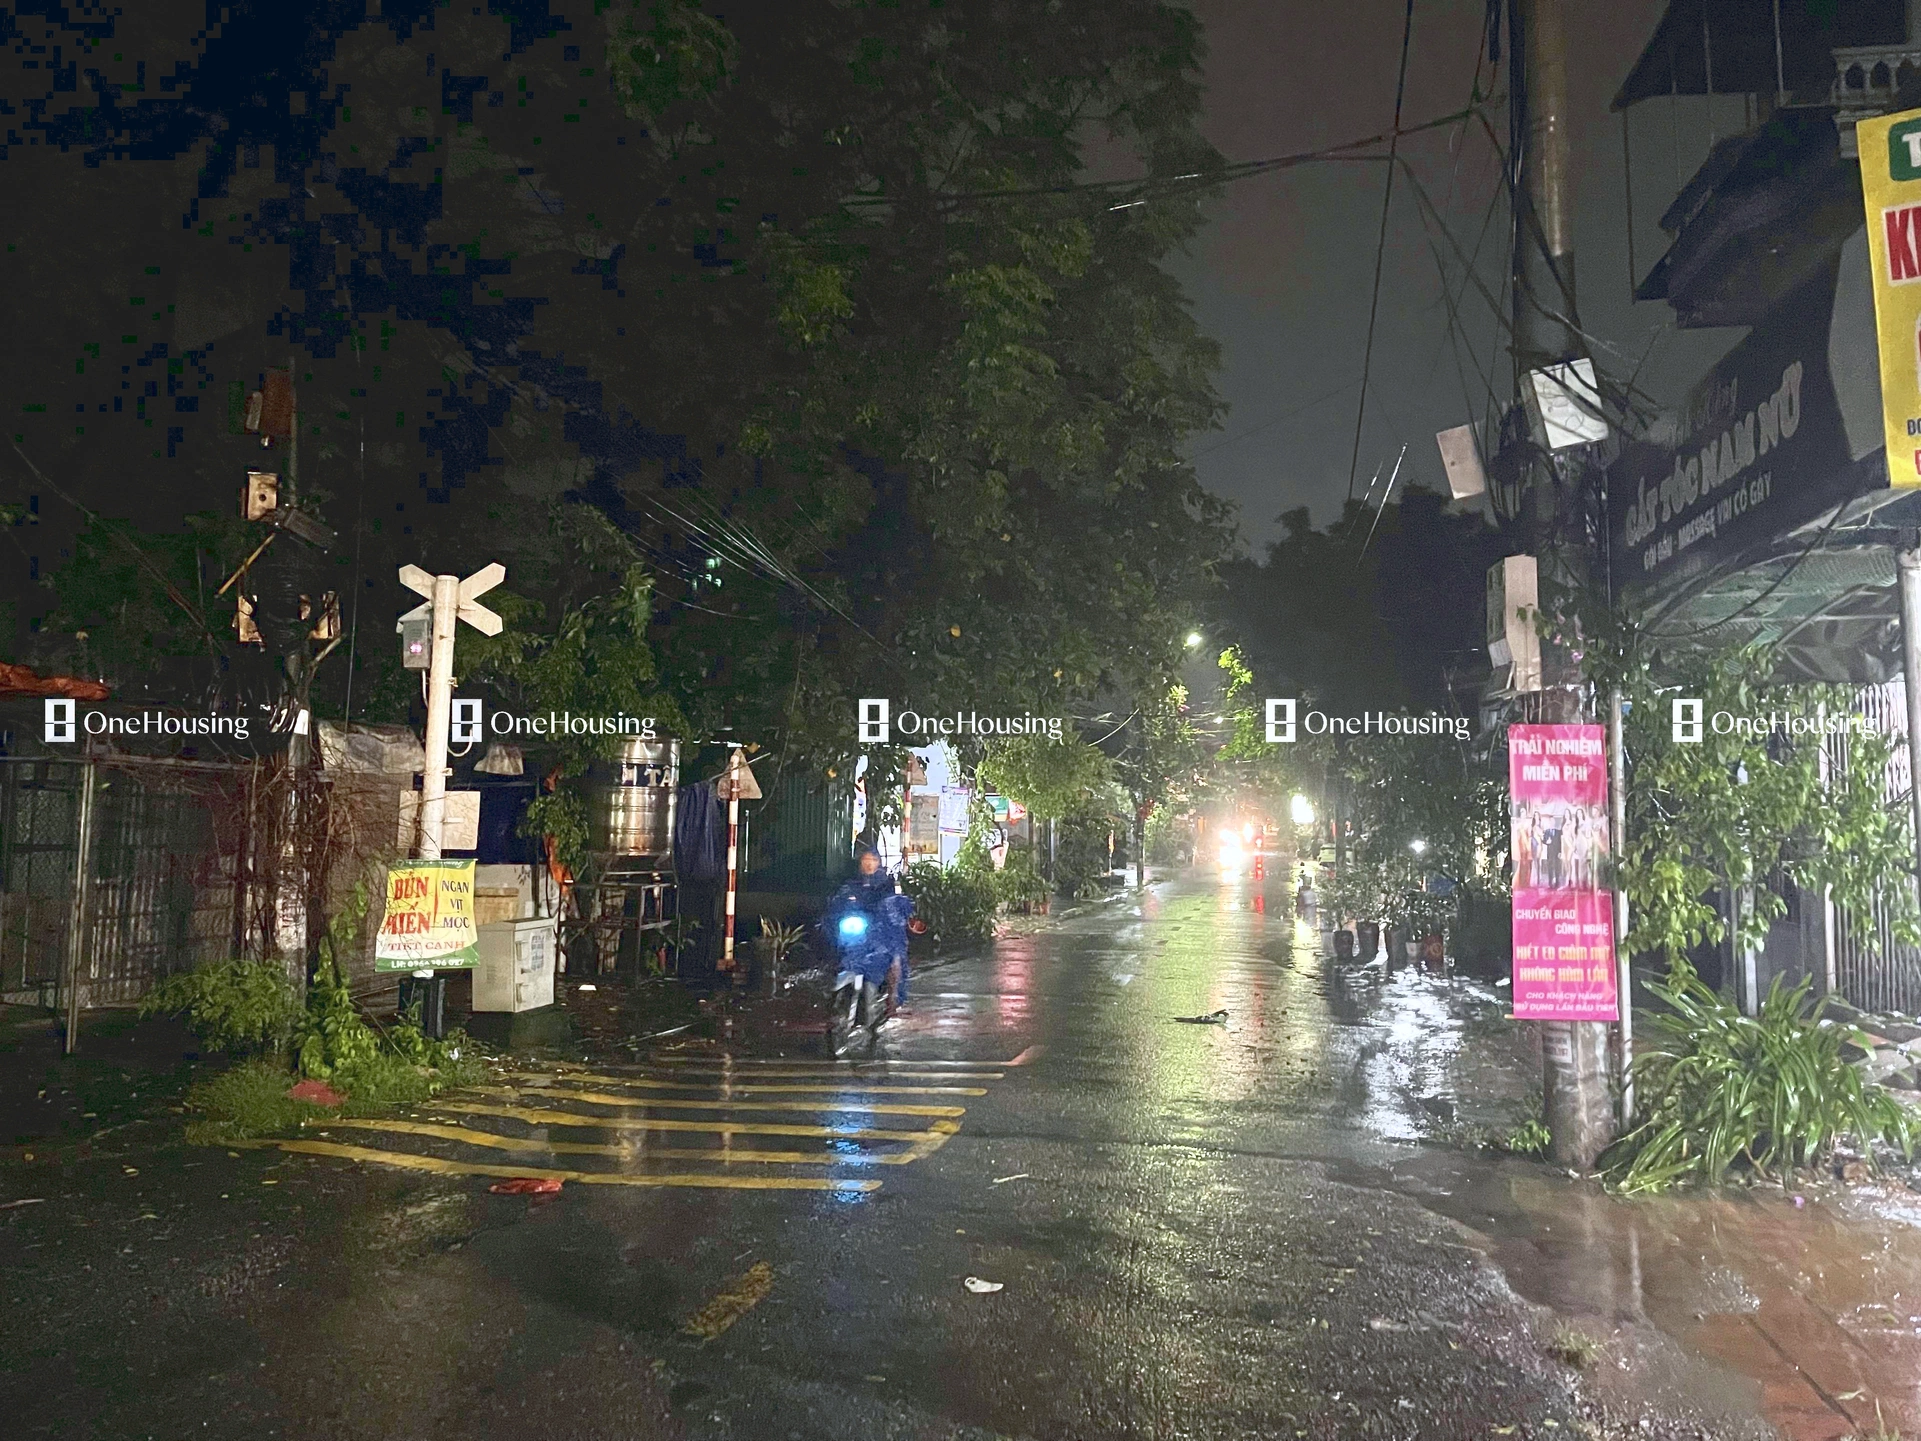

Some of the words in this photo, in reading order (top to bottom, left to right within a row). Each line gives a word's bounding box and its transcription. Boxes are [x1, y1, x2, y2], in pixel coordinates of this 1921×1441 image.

[1660, 455, 1698, 523] TÓC
[1700, 411, 1755, 495] NAM
[1545, 736, 1602, 757] NGHIỆM
[1563, 762, 1588, 781] PHÍ
[442, 880, 469, 893] NGAN
[450, 899, 463, 913] VỊT
[1554, 909, 1576, 920] GIAO
[443, 917, 470, 932] MỌC
[1555, 922, 1581, 935] CÔNG
[426, 940, 465, 951] CANH
[1526, 992, 1544, 1000] CHO
